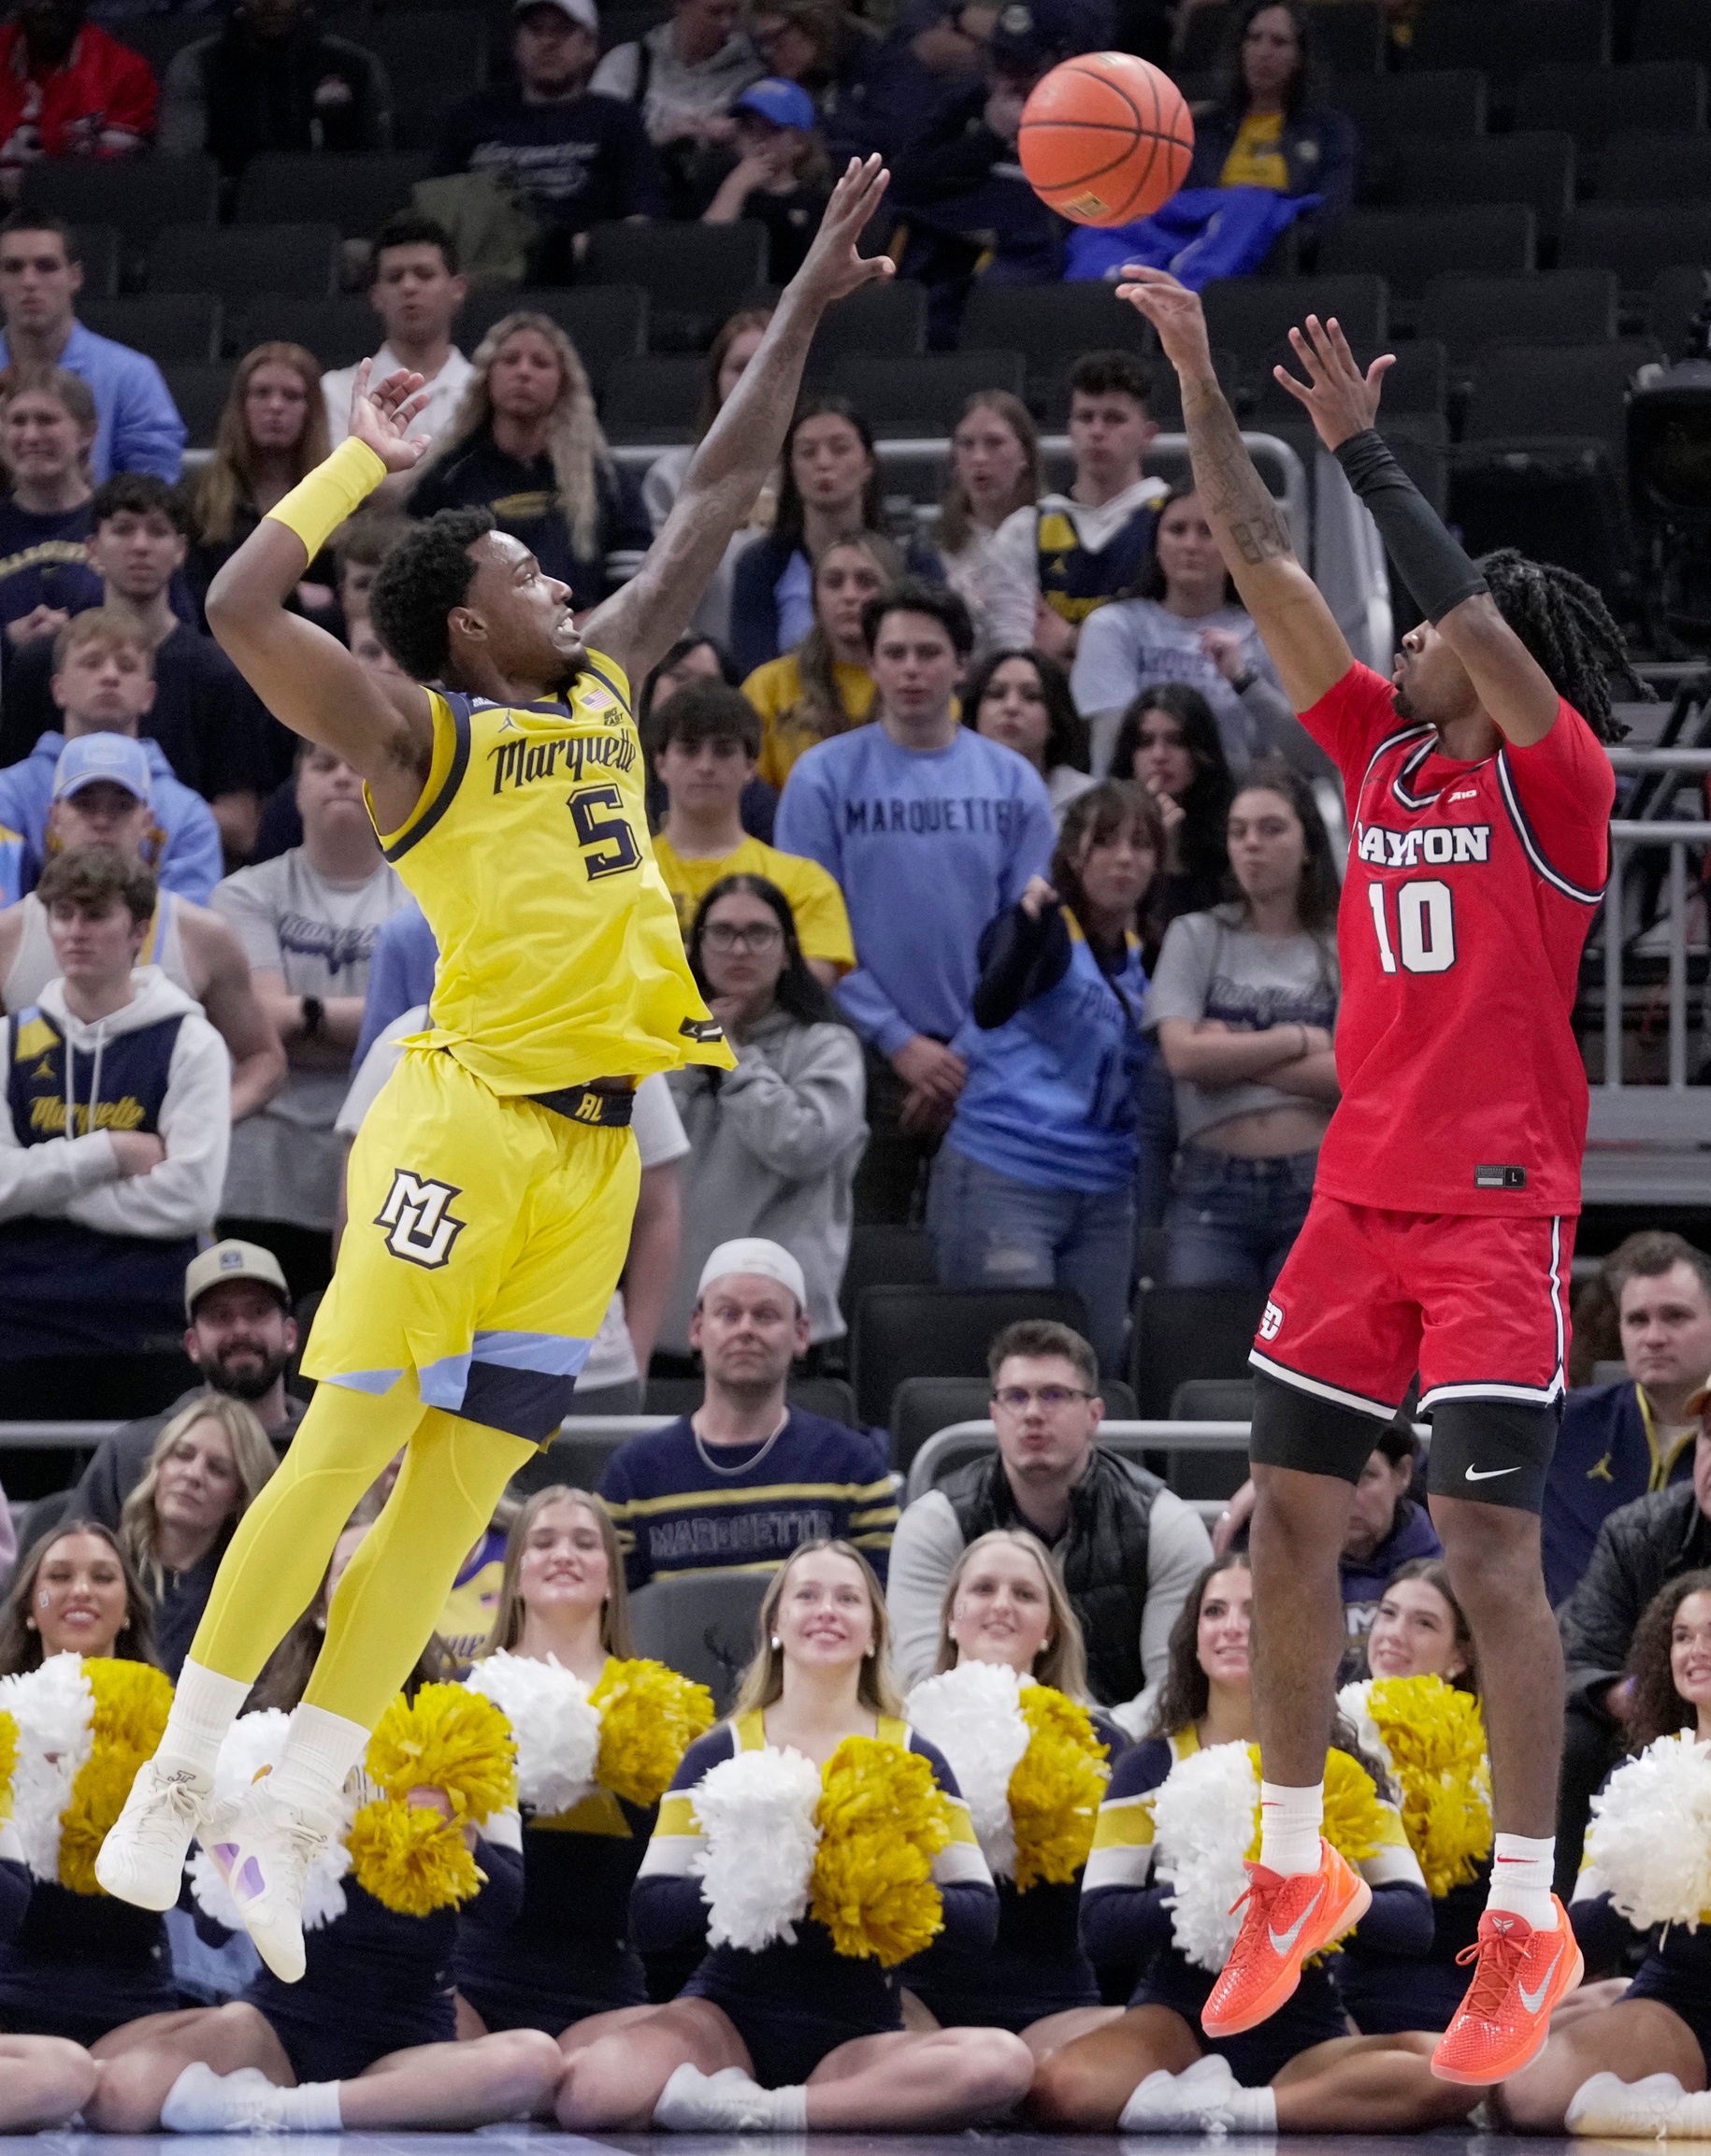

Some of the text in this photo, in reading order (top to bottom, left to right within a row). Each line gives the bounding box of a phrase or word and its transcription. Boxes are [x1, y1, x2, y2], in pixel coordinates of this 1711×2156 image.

[604, 707, 617, 719] BIG
[604, 712, 624, 726] EAST
[487, 728, 637, 795] Marquette
[566, 783, 642, 882] 5
[1358, 820, 1492, 869] AYTON
[1368, 880, 1458, 973] 10
[1512, 1171, 1517, 1183] L
[373, 1168, 467, 1270] MU
